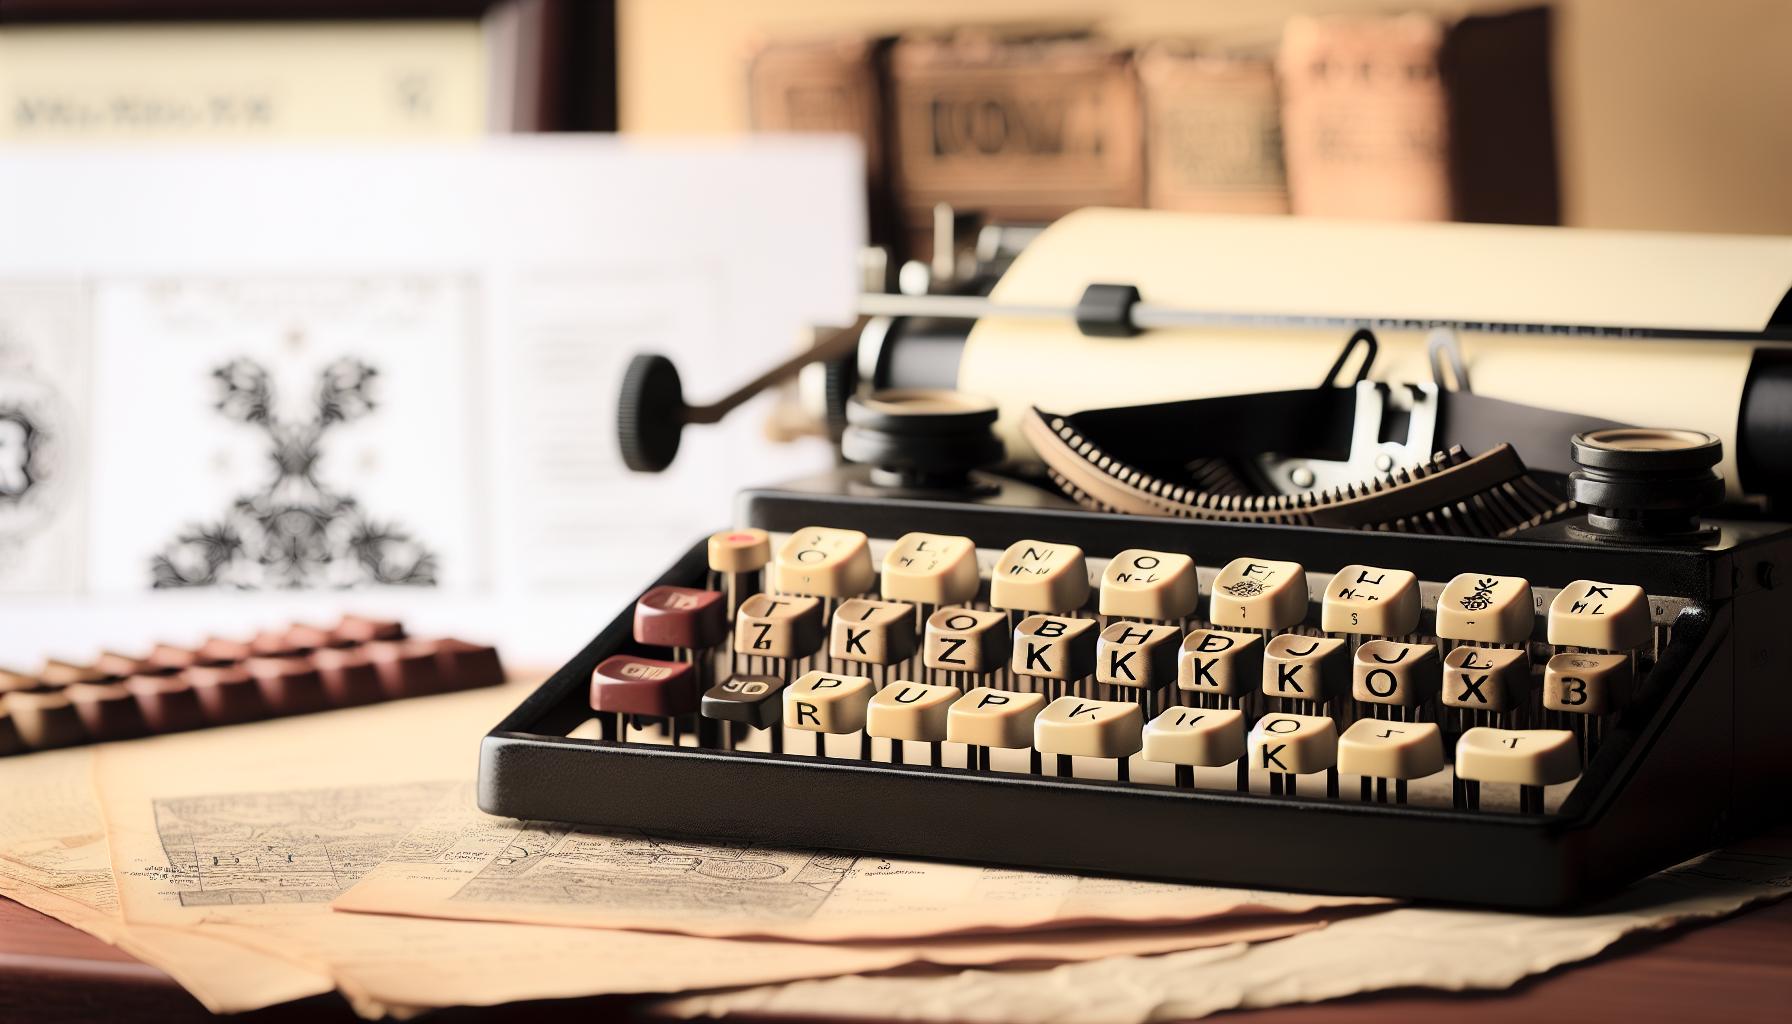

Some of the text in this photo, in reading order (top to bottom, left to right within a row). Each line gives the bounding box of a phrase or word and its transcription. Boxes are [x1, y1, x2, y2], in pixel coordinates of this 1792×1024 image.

[1134, 556, 1160, 570] O
[945, 615, 978, 630] O
[1034, 620, 1068, 637] B
[846, 628, 871, 655] K
[1117, 627, 1153, 645] H
[938, 638, 966, 665] Z
[1026, 643, 1052, 672] K
[1110, 650, 1137, 681] K
[1194, 658, 1219, 687] K
[1278, 664, 1304, 692] K
[811, 677, 842, 691] P
[894, 687, 928, 703] U
[1365, 669, 1397, 697] O
[1458, 674, 1488, 703] X
[796, 701, 821, 726] R
[977, 694, 1010, 708] P
[1265, 719, 1300, 733] O
[1262, 743, 1287, 770] K
